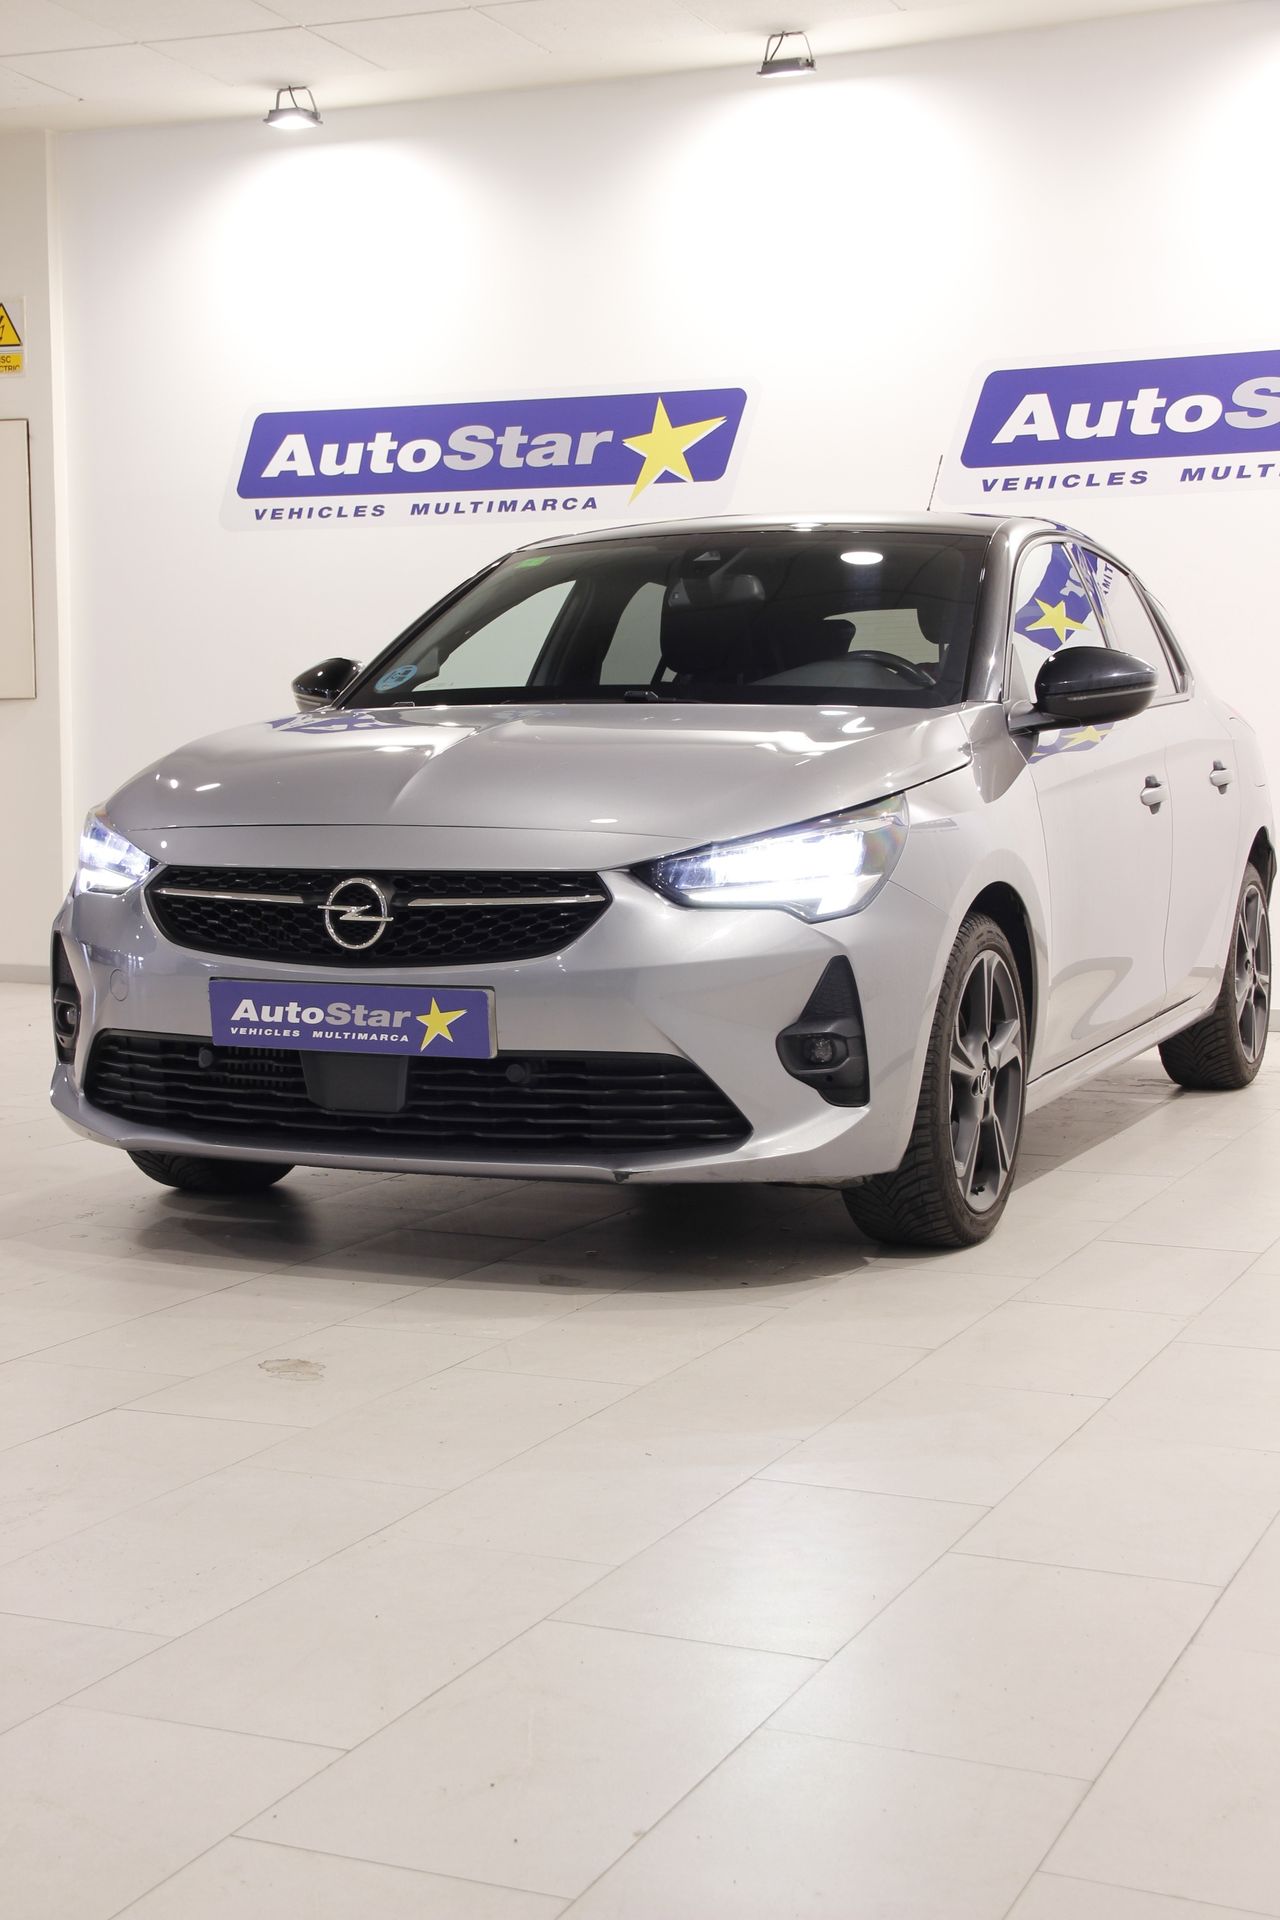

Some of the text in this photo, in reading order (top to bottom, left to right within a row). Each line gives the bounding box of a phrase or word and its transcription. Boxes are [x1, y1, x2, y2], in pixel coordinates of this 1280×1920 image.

[991, 376, 1280, 444] AutoS
[260, 425, 614, 478] AutoStar
[981, 463, 1280, 492] VEHICLES MULT
[254, 497, 598, 521] VEHICLES MULTIMARCA
[230, 998, 412, 1028] AutoStar
[230, 1027, 410, 1042] VEHICLES MULTIMARCA
